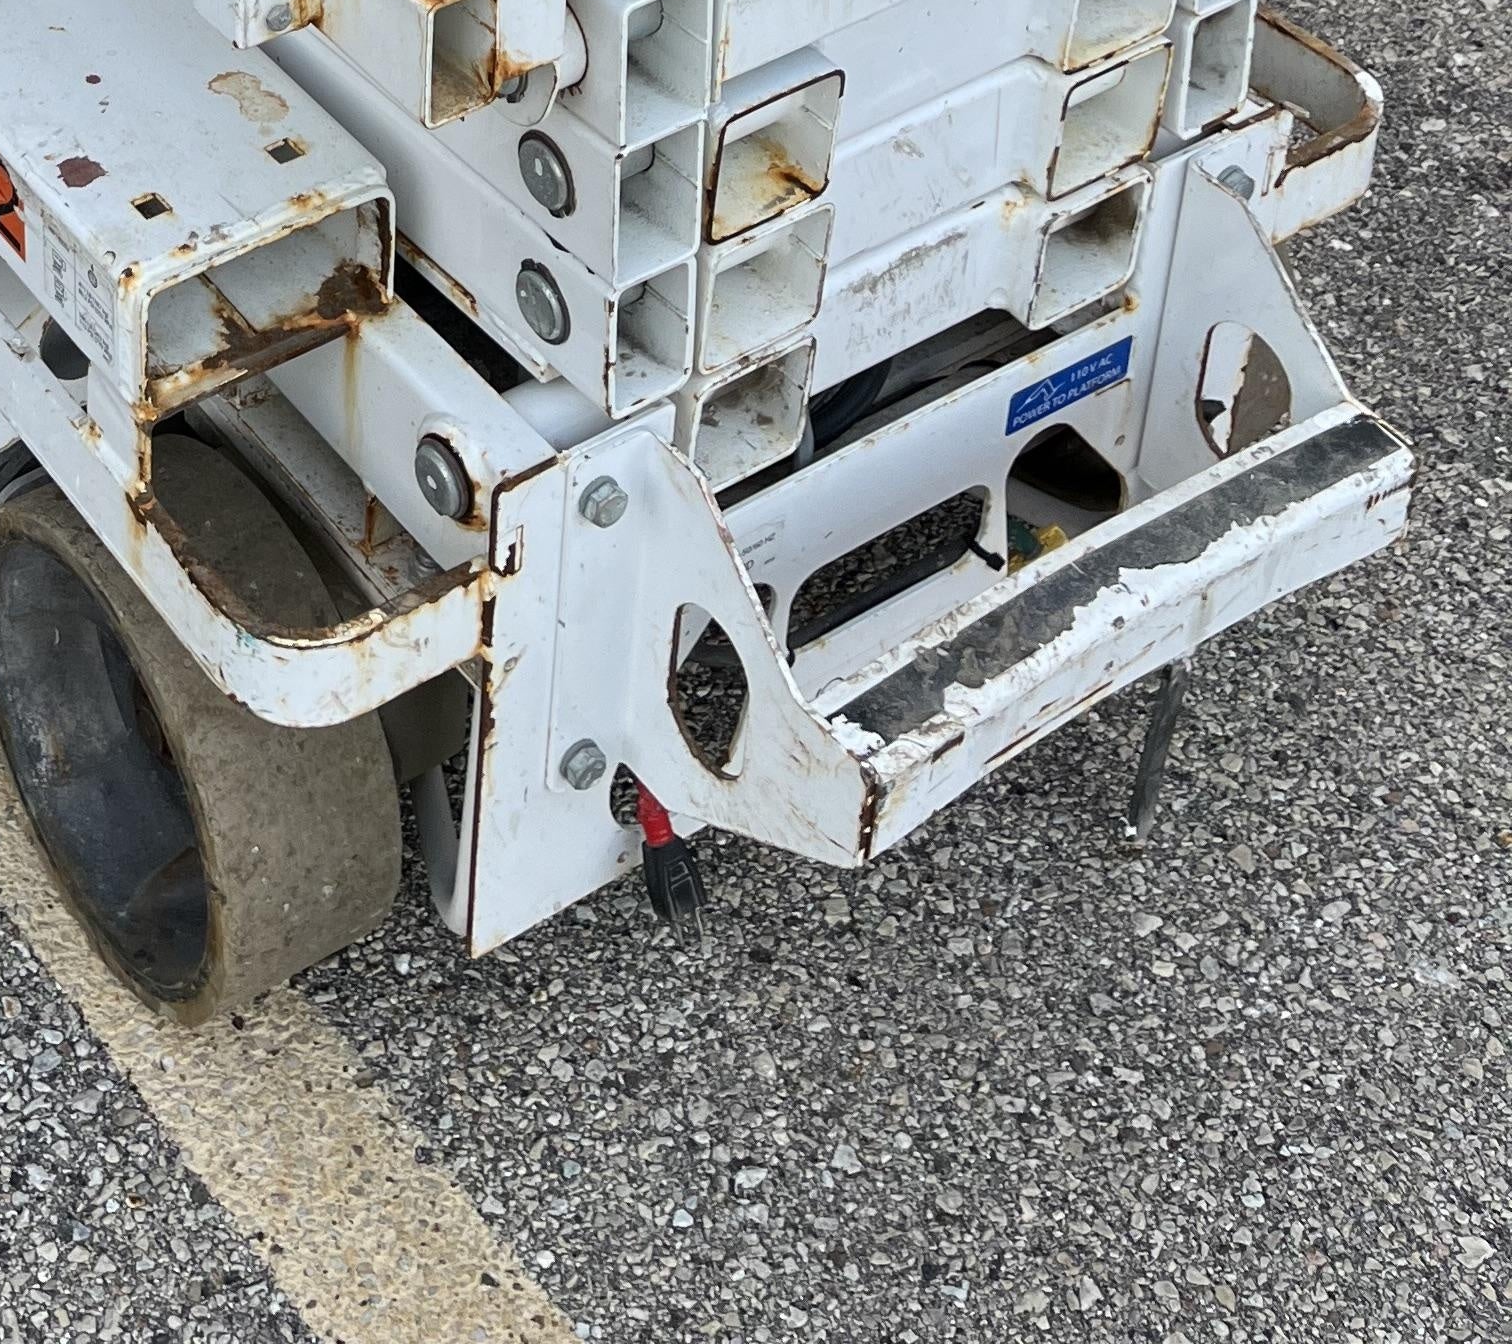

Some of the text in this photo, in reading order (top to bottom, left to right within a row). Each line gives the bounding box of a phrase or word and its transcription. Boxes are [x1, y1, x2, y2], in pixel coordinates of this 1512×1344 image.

[1012, 365, 1122, 427] POWER TO PLATFORM
